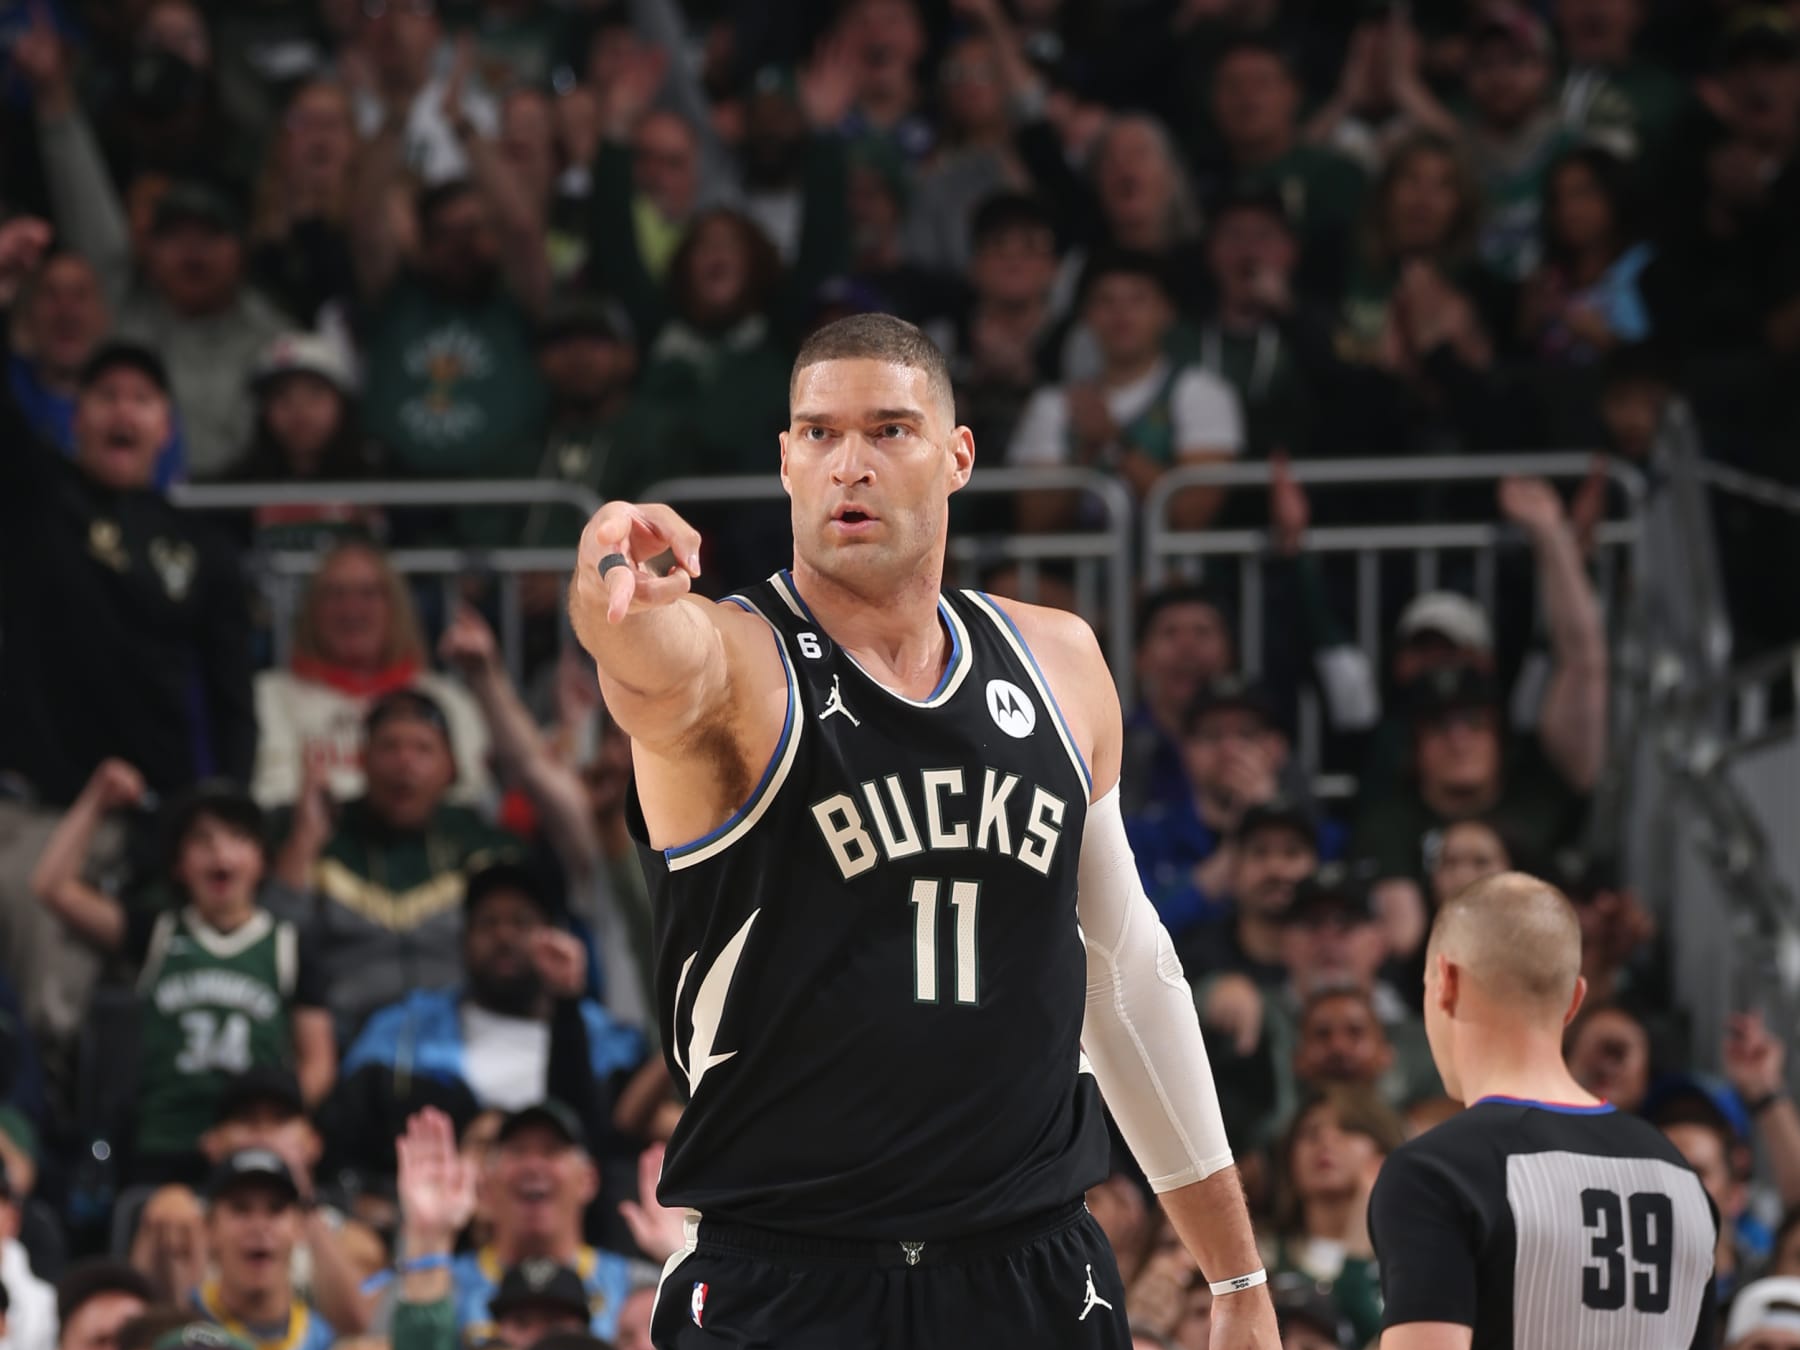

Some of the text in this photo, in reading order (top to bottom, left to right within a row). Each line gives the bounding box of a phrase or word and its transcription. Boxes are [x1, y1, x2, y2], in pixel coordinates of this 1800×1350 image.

[797, 632, 822, 659] 6
[809, 765, 1068, 883] BUCKS
[908, 877, 983, 1006] 11
[177, 1011, 252, 1074] 34
[1580, 1188, 1674, 1315] 39
